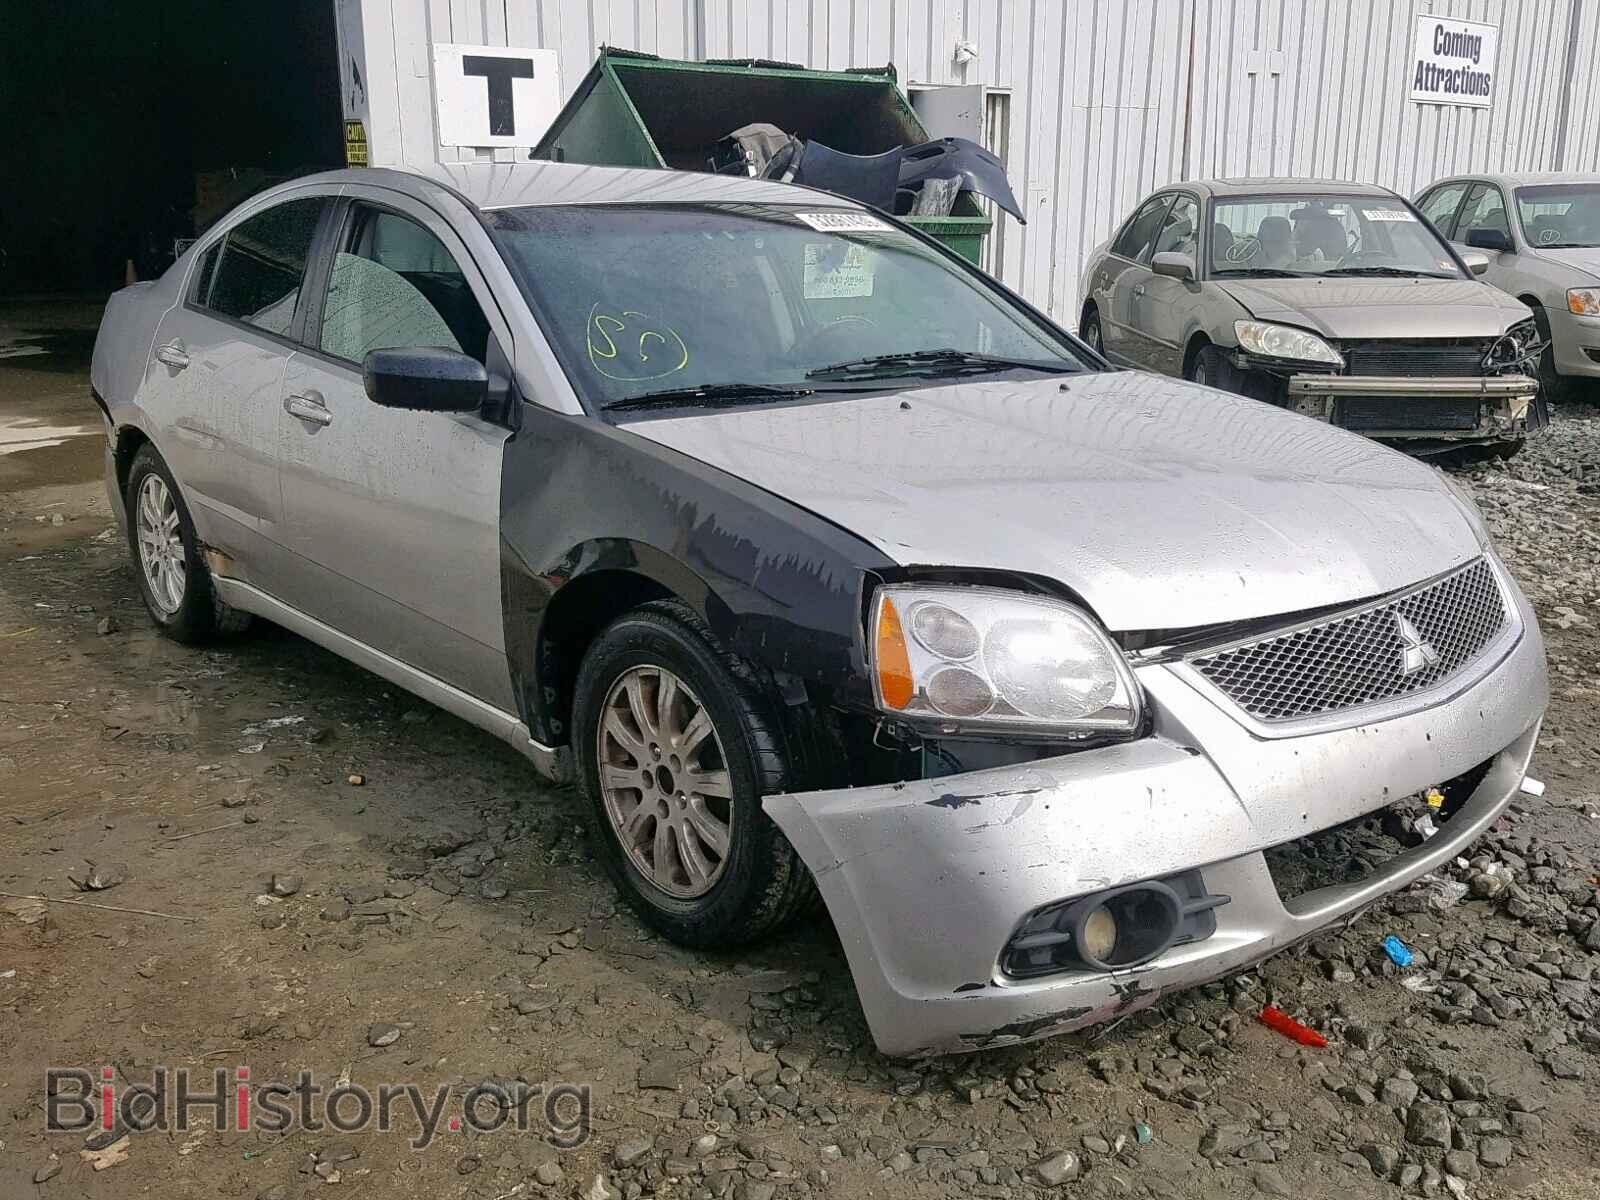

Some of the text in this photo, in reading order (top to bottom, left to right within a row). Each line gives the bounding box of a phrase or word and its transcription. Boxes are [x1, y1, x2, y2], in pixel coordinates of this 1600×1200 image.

[1433, 23, 1482, 64] Coming
[463, 55, 534, 137] T
[1413, 60, 1491, 97] Attractions
